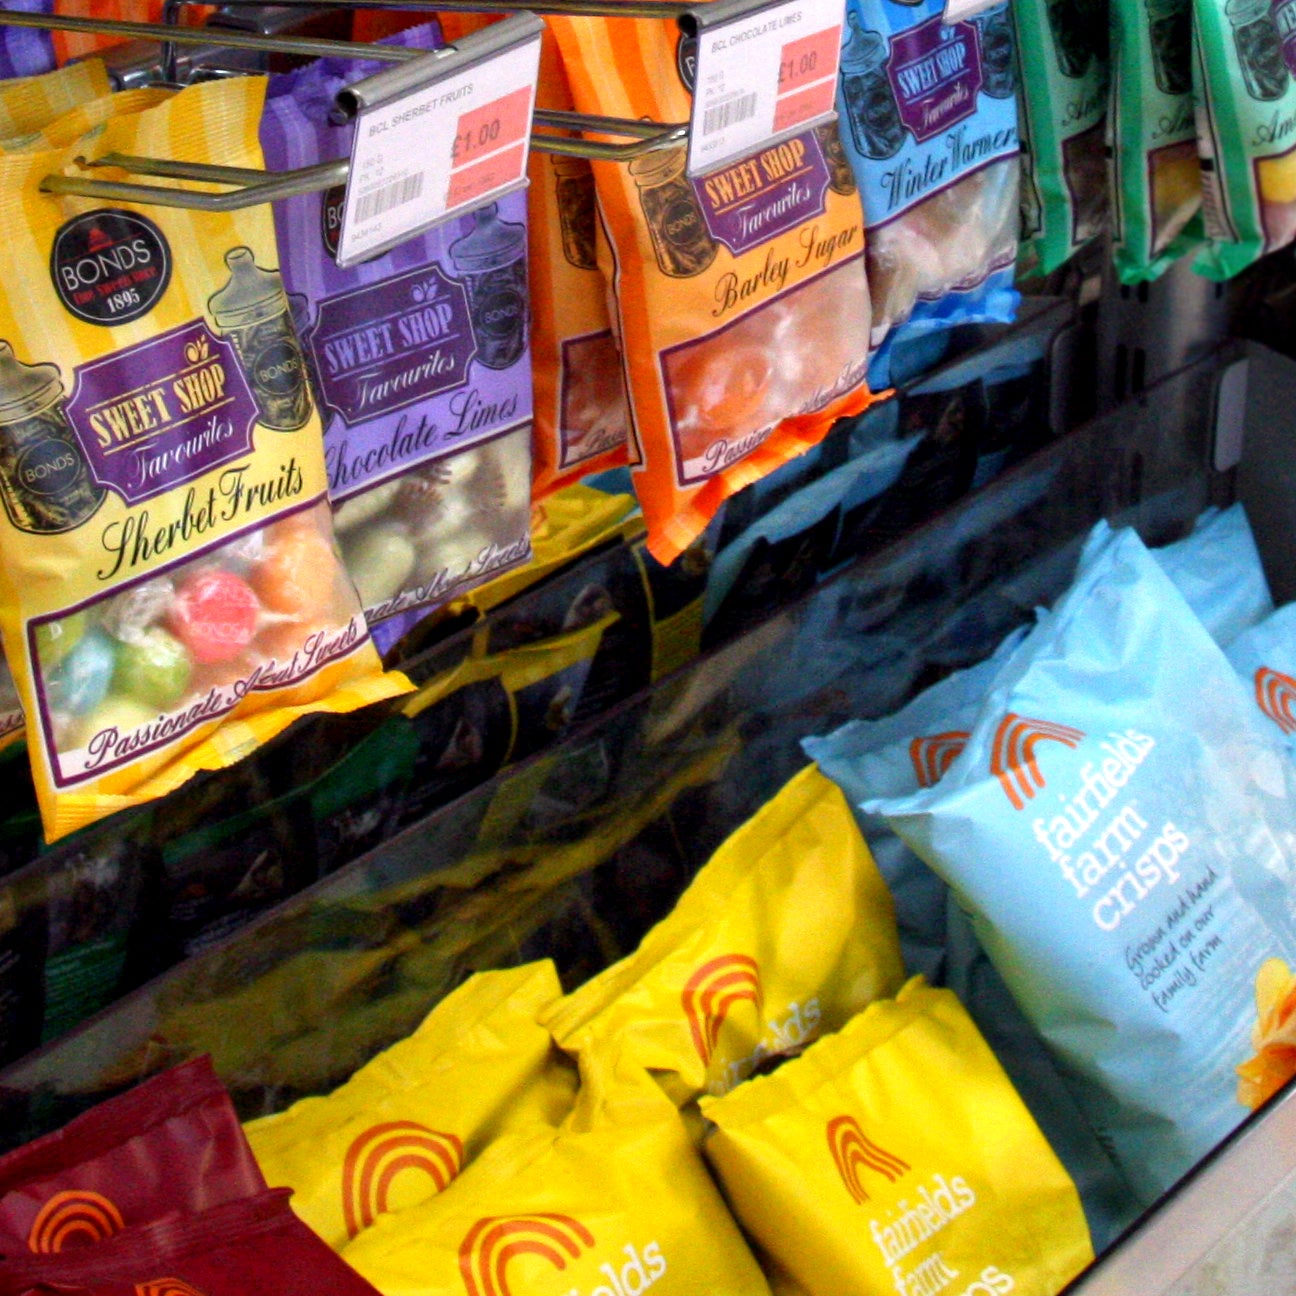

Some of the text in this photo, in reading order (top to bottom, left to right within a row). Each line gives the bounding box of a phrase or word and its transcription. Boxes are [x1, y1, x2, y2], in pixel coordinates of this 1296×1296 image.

[730, 20, 778, 47] CHOCOLATE
[778, 10, 803, 30] LIMES
[777, 51, 817, 84] £1.00
[897, 41, 966, 100] SWEET SHOP
[369, 82, 475, 138] BCL SHERBET FRUITS
[450, 119, 501, 158] £1.00
[704, 137, 805, 209] SWEET SHOP
[880, 150, 948, 212] Winter
[733, 181, 811, 242] Favourites
[61, 239, 151, 291] BONDS
[711, 224, 857, 317] Barley Sugar
[106, 288, 141, 314] 1895
[259, 360, 300, 384] BONDS
[325, 305, 453, 375] SWEET SHOP
[89, 363, 227, 450] SWEET SHOP
[356, 350, 455, 409] Favourites
[24, 455, 75, 483] BONDS
[127, 416, 234, 491] Favourites
[325, 389, 519, 492] Chocolate Limes
[96, 456, 304, 580] Sherbet Fruits
[85, 689, 226, 770] Passionate
[225, 663, 302, 705] About
[298, 617, 358, 674] Sweets
[1032, 728, 1157, 863] fairfields
[1057, 799, 1149, 899] farm
[1092, 821, 1191, 932] crisps
[1125, 865, 1219, 979] Grown and hand
[1140, 905, 1215, 992] cooked on our
[1150, 933, 1224, 1014] family farm
